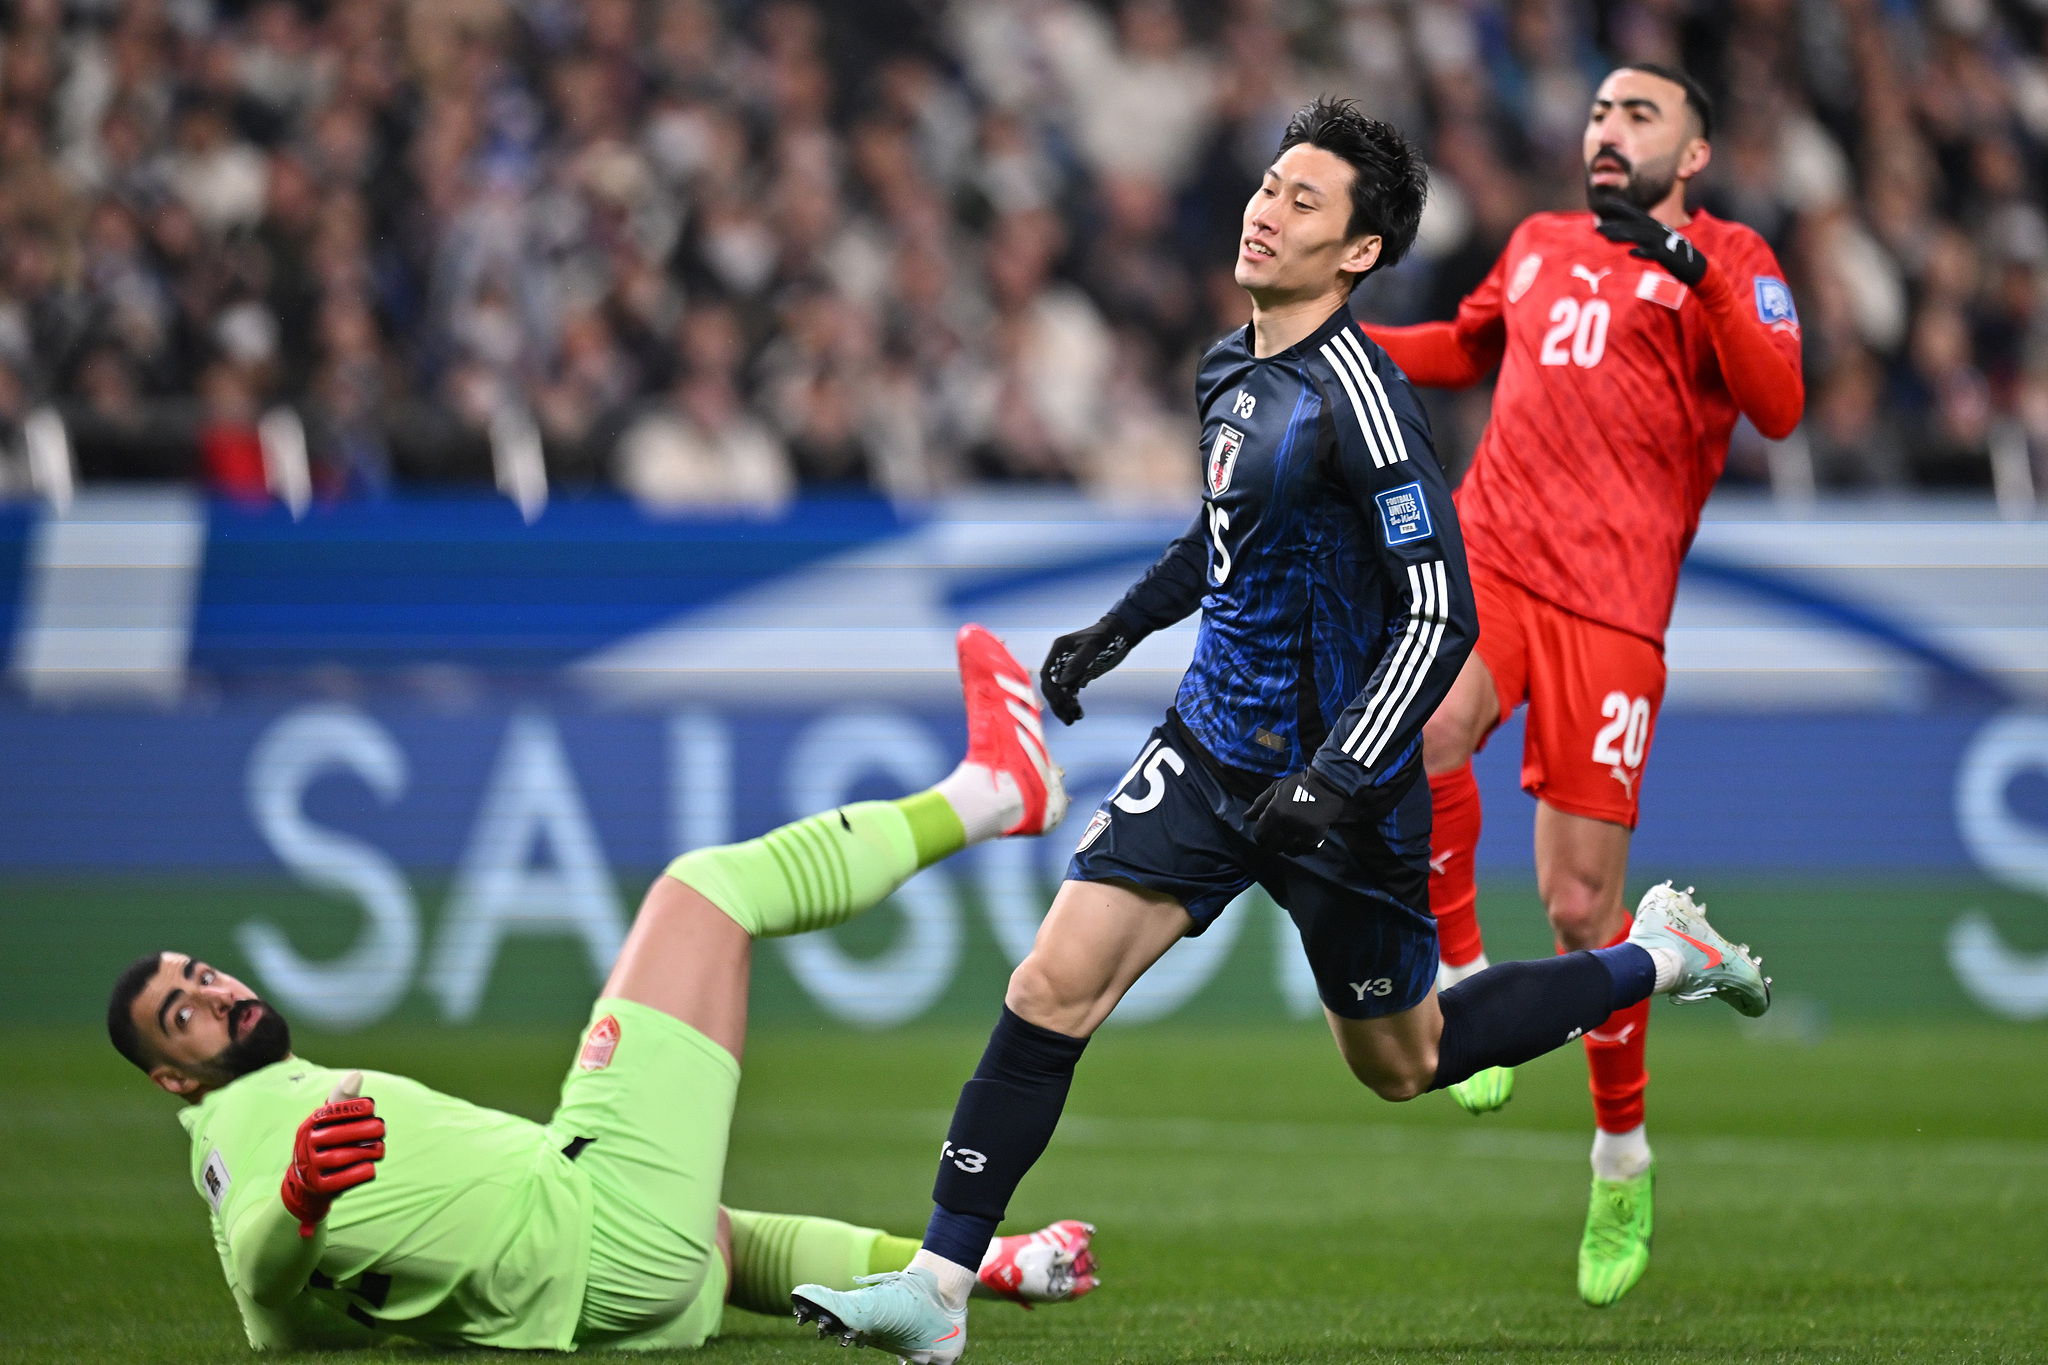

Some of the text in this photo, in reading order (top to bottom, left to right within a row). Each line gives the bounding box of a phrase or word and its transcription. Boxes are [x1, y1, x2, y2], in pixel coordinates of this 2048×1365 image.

[1540, 296, 1612, 369] 20
[1232, 389, 1256, 419] Y-3
[1385, 493, 1415, 506] FOOTBALL
[1388, 501, 1417, 517] UNITES
[1399, 510, 1421, 523] World
[1592, 690, 1651, 769] 20
[1106, 738, 1186, 814] 15
[235, 702, 1325, 1032] SASO
[1348, 977, 1394, 1002] Y-3
